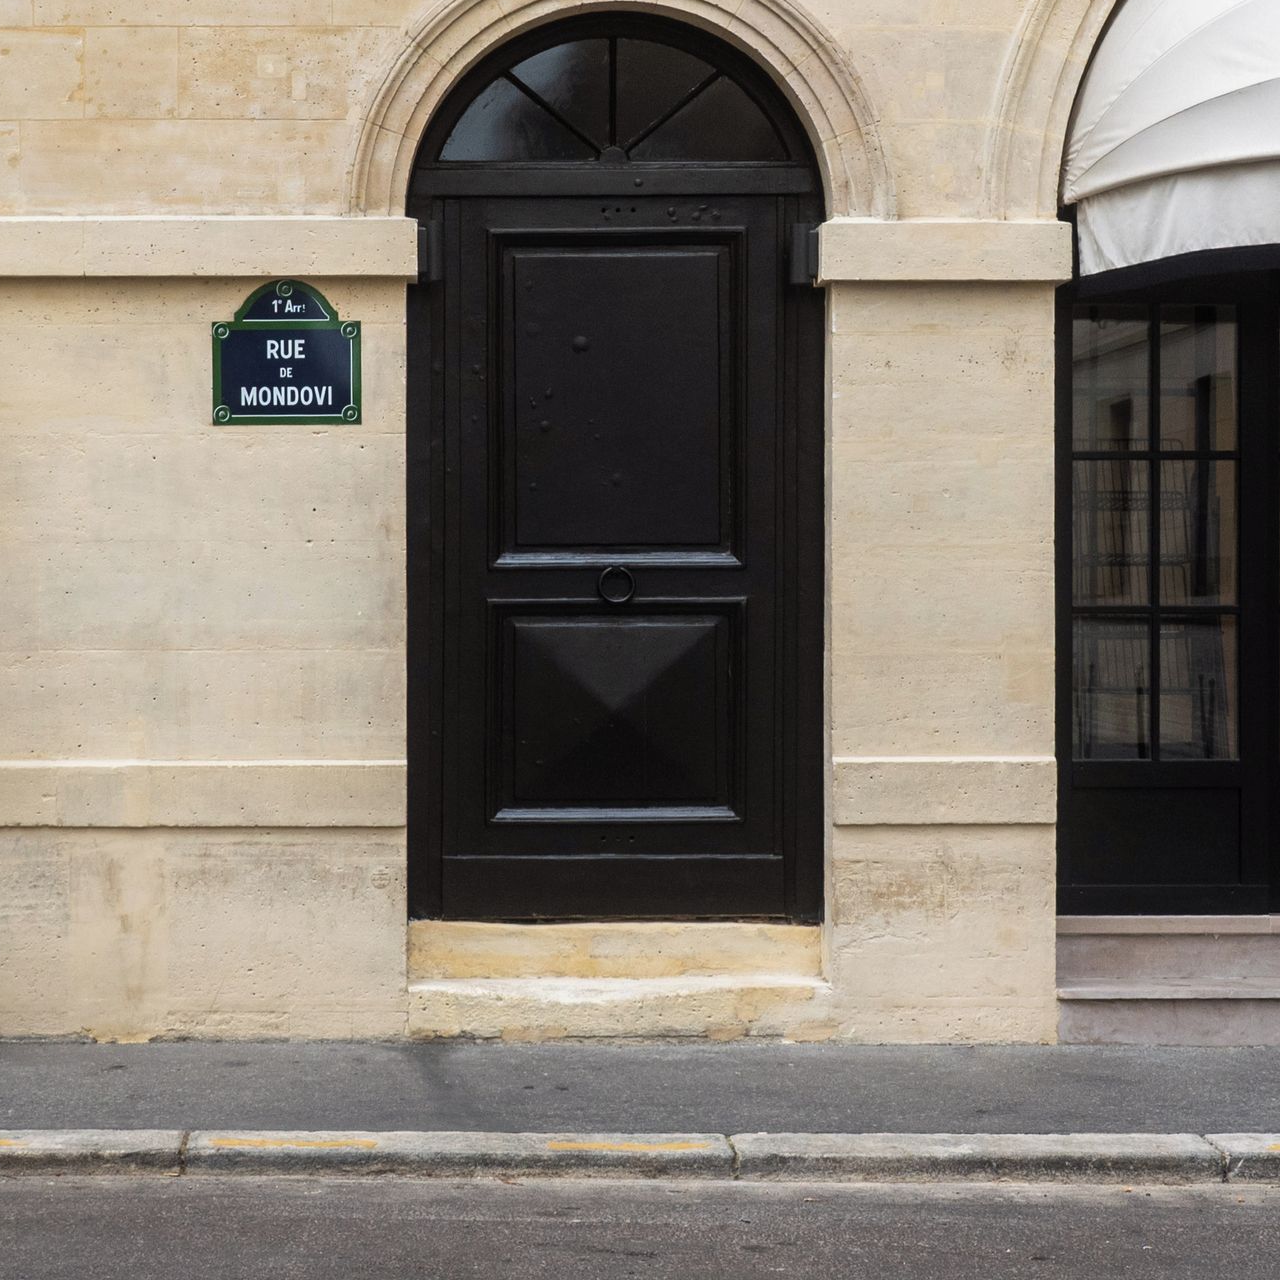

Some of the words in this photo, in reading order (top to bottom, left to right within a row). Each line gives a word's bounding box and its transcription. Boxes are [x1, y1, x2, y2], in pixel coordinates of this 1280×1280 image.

[266, 339, 306, 359] RUE
[279, 367, 293, 378] DE
[240, 386, 333, 406] MONDOVI
